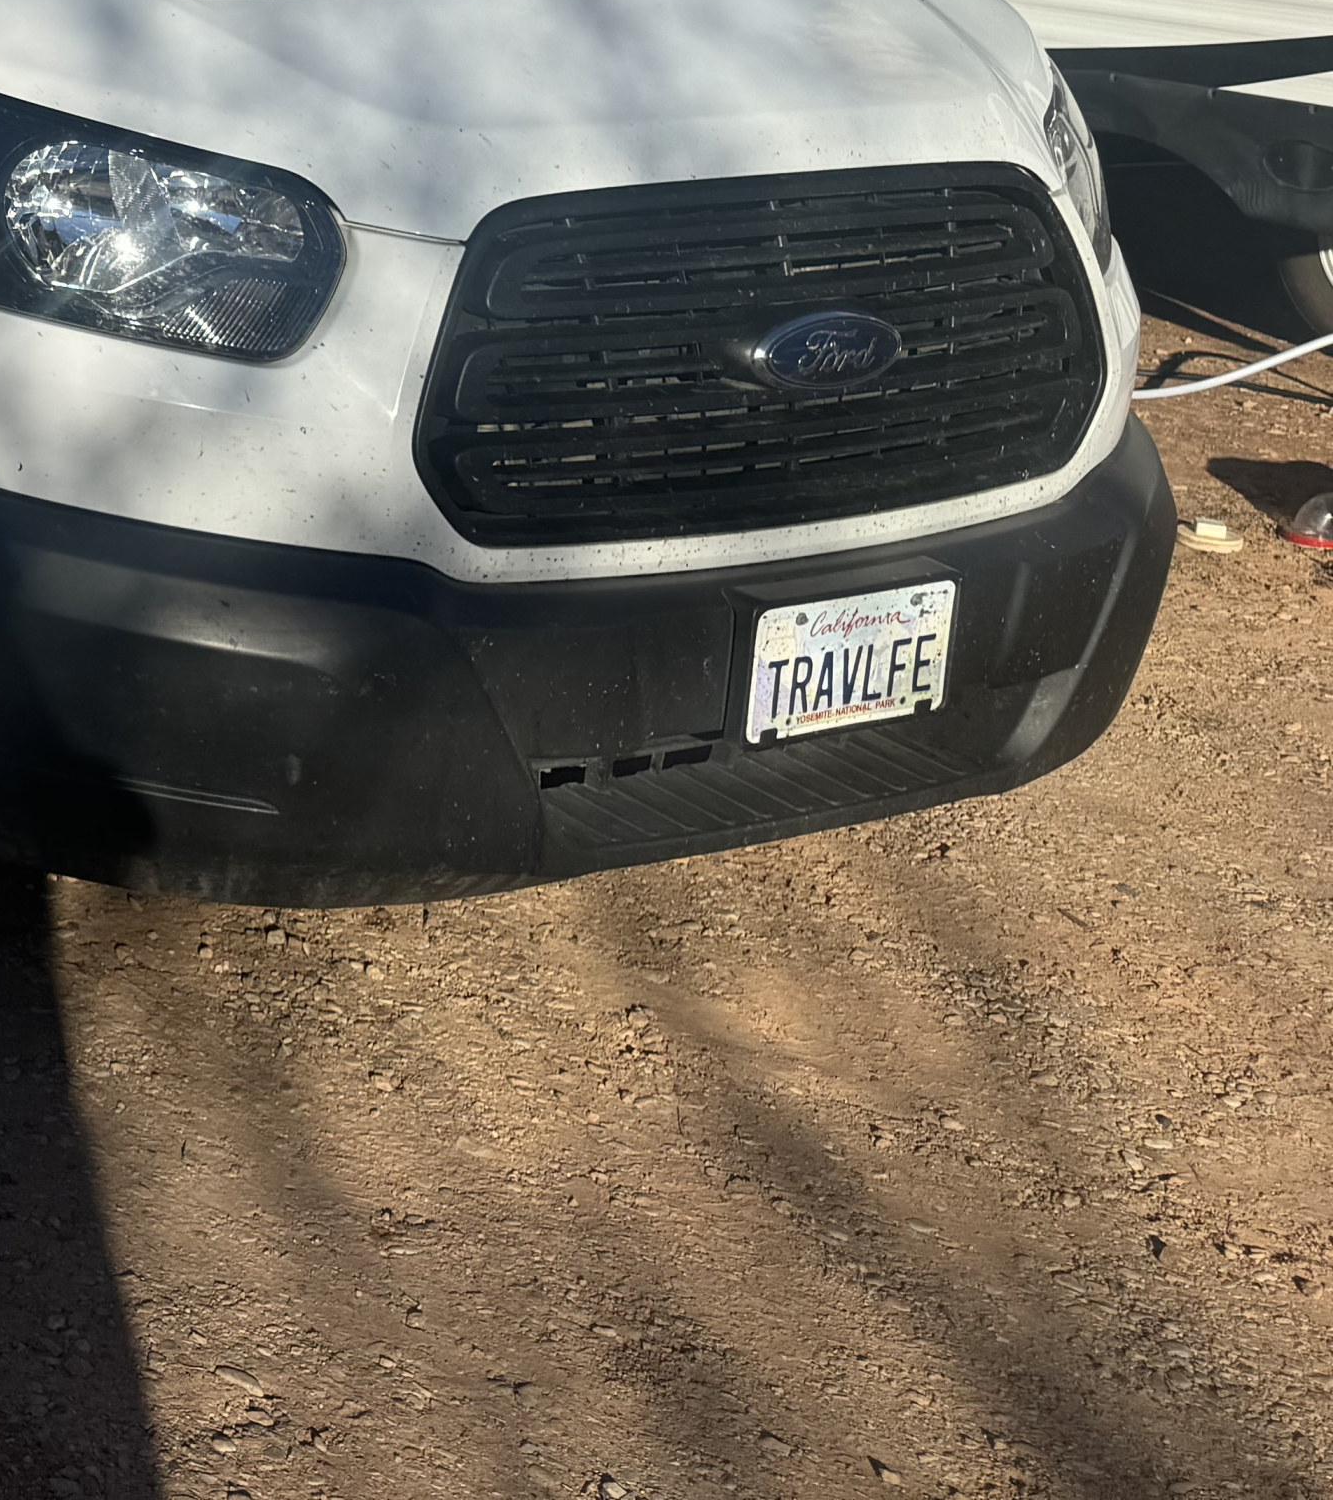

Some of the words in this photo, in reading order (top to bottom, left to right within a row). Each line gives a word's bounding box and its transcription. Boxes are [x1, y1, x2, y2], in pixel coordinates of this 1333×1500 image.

[797, 328, 878, 376] Ford
[810, 607, 912, 639] California
[767, 633, 938, 719] TRAVLFE
[796, 709, 833, 725] YOSEMITE
[835, 702, 872, 716] NATIONAL
[875, 698, 896, 710] PARK
